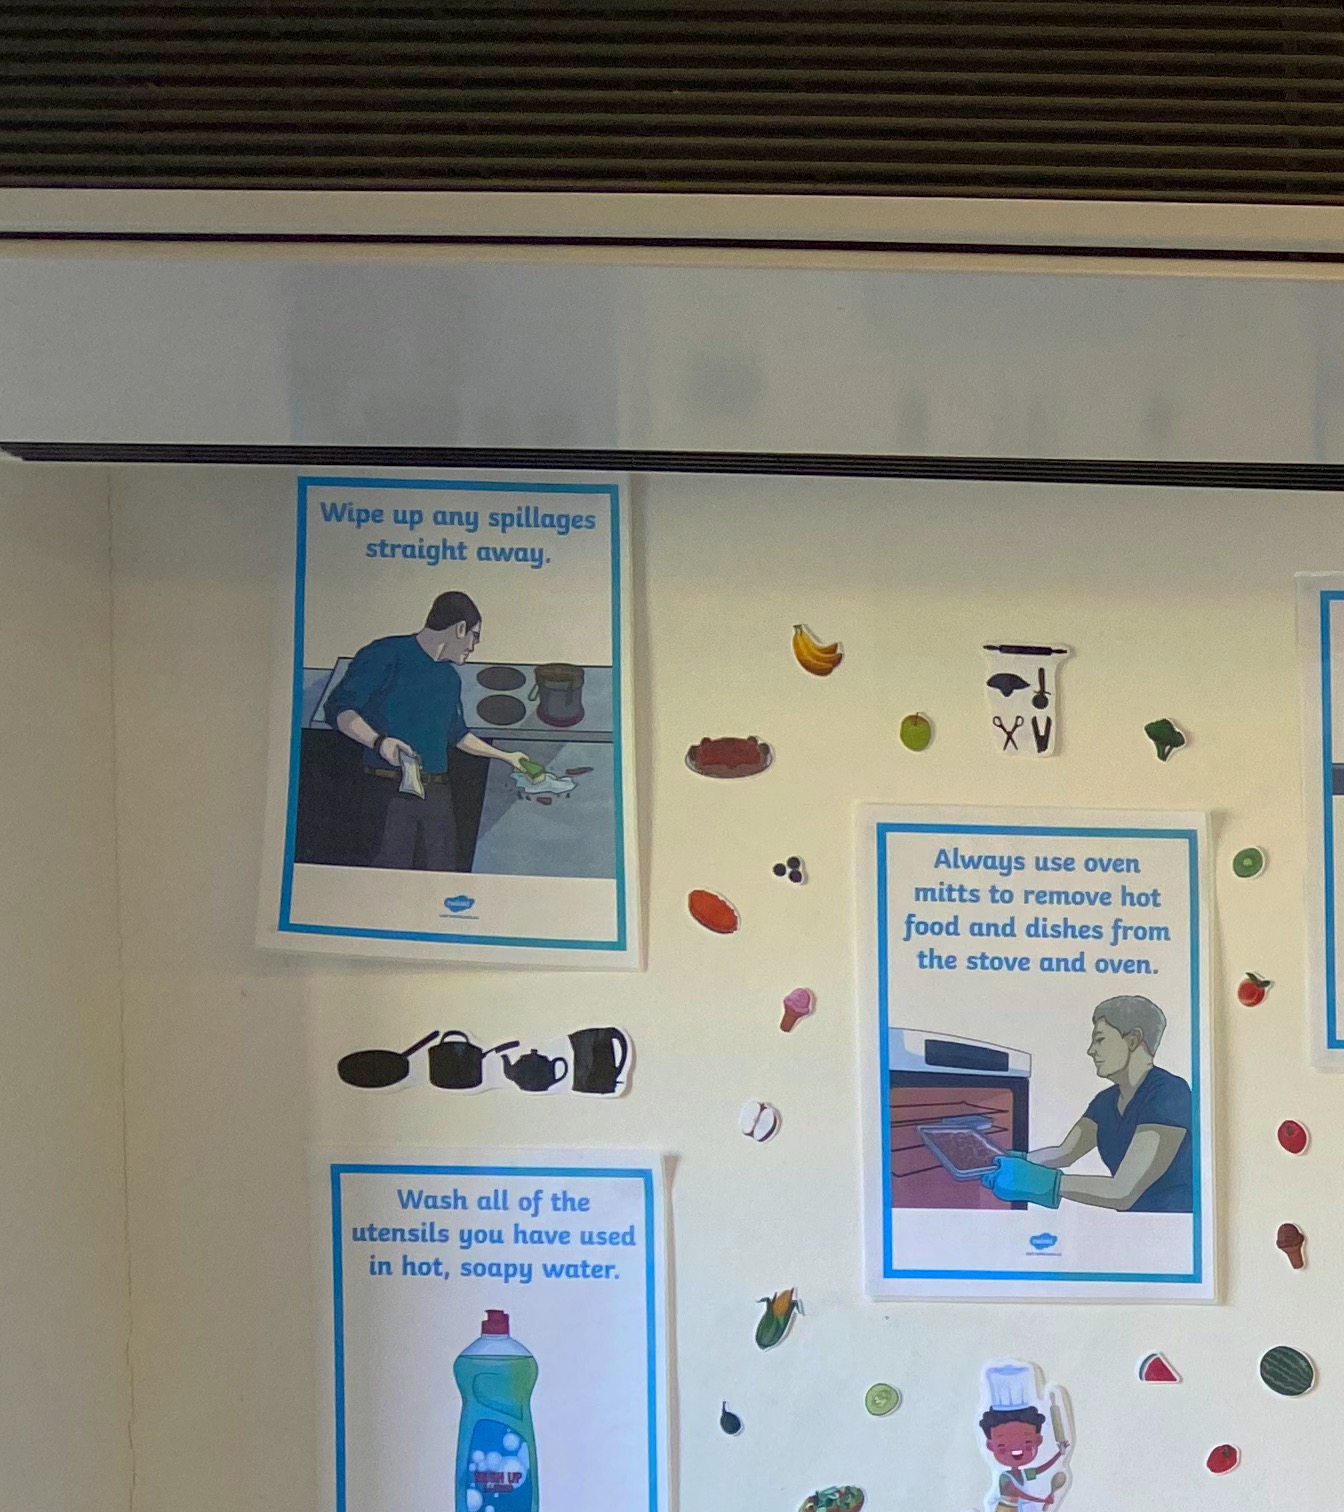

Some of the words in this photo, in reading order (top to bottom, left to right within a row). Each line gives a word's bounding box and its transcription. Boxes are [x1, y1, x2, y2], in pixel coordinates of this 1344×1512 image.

[320, 501, 384, 529] Wipe
[393, 507, 423, 530] up
[432, 508, 479, 533] any
[488, 505, 597, 535] spillages
[365, 538, 467, 566] straight
[477, 545, 551, 569] away.
[933, 848, 1025, 876] Always
[1034, 856, 1075, 871] use
[1083, 857, 1141, 873] oven
[914, 881, 981, 903] mitts
[988, 884, 1014, 904] to
[1023, 888, 1112, 906] remove
[1121, 885, 1162, 907] hot
[903, 913, 960, 942] food
[969, 916, 1017, 938] and
[1025, 917, 1103, 940] dishes
[1110, 918, 1171, 946] from
[917, 948, 957, 970] the
[966, 951, 1030, 972] stove
[1040, 951, 1086, 973] and
[1095, 957, 1159, 975] oven.
[397, 1188, 467, 1211] Wash
[477, 1189, 508, 1211] all
[518, 1189, 543, 1217] of
[551, 1190, 590, 1212] the
[352, 1221, 450, 1243] utensils
[459, 1228, 505, 1250] you
[514, 1223, 571, 1246] have
[580, 1224, 636, 1246] used
[369, 1254, 393, 1276] in
[402, 1254, 450, 1280] hot,
[460, 1261, 532, 1284] soapy
[543, 1261, 620, 1280] water.
